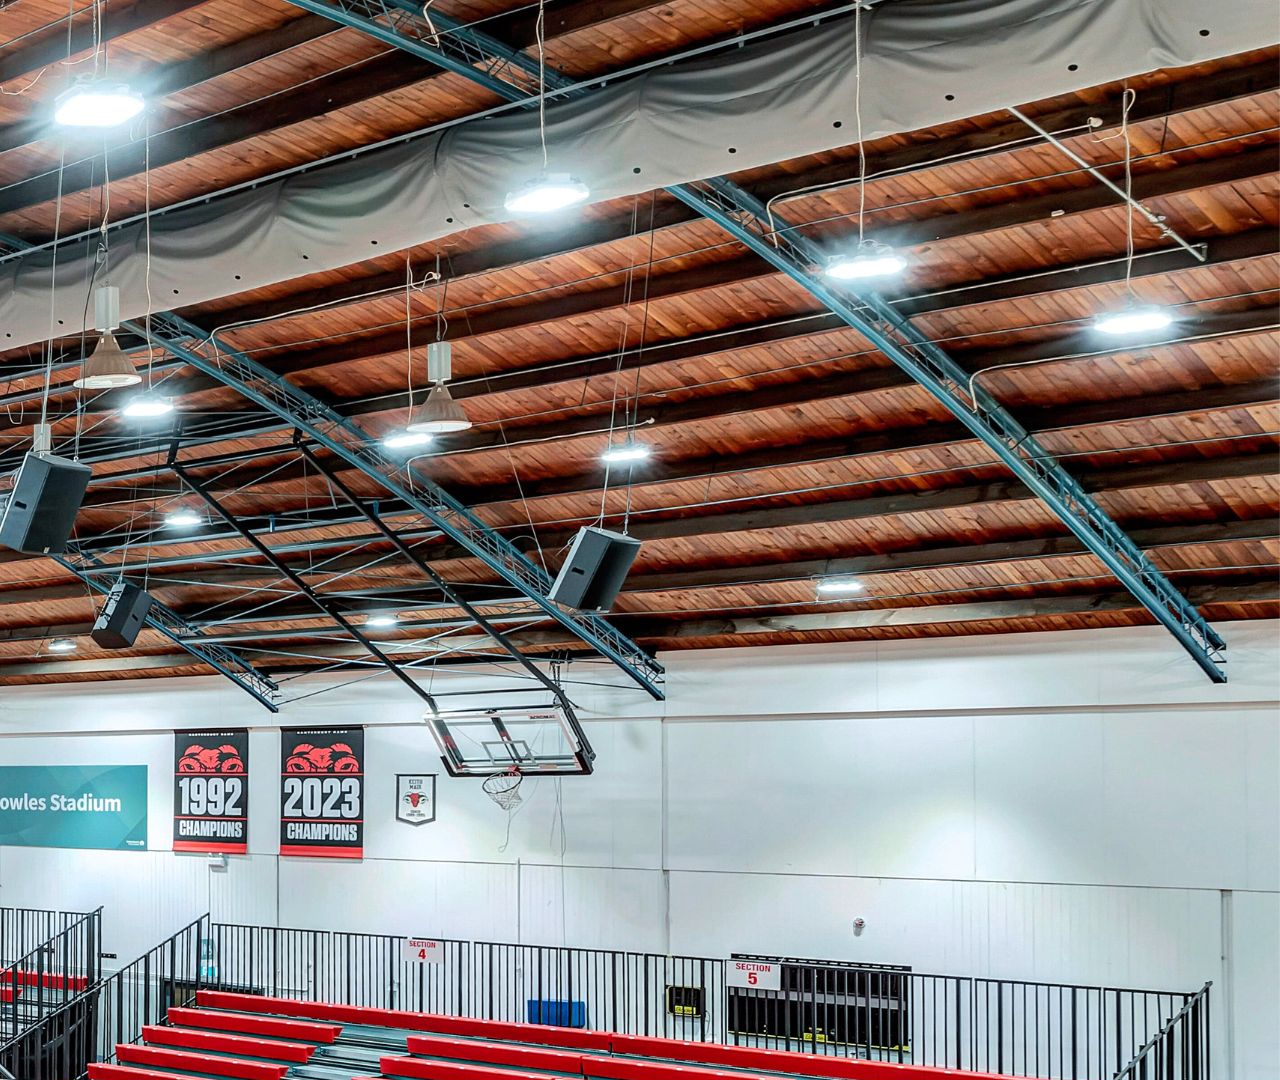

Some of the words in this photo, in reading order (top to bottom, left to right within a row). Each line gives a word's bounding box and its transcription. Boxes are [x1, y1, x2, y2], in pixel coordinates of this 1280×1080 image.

[50, 793, 121, 812] Stadium
[179, 777, 242, 816] 1992
[284, 777, 360, 818] 2023
[179, 820, 242, 837] CHAMPIONS
[287, 823, 358, 841] CHAMPIONS
[418, 949, 426, 959] 4
[736, 963, 771, 972] SECTION
[748, 972, 758, 985] 5
